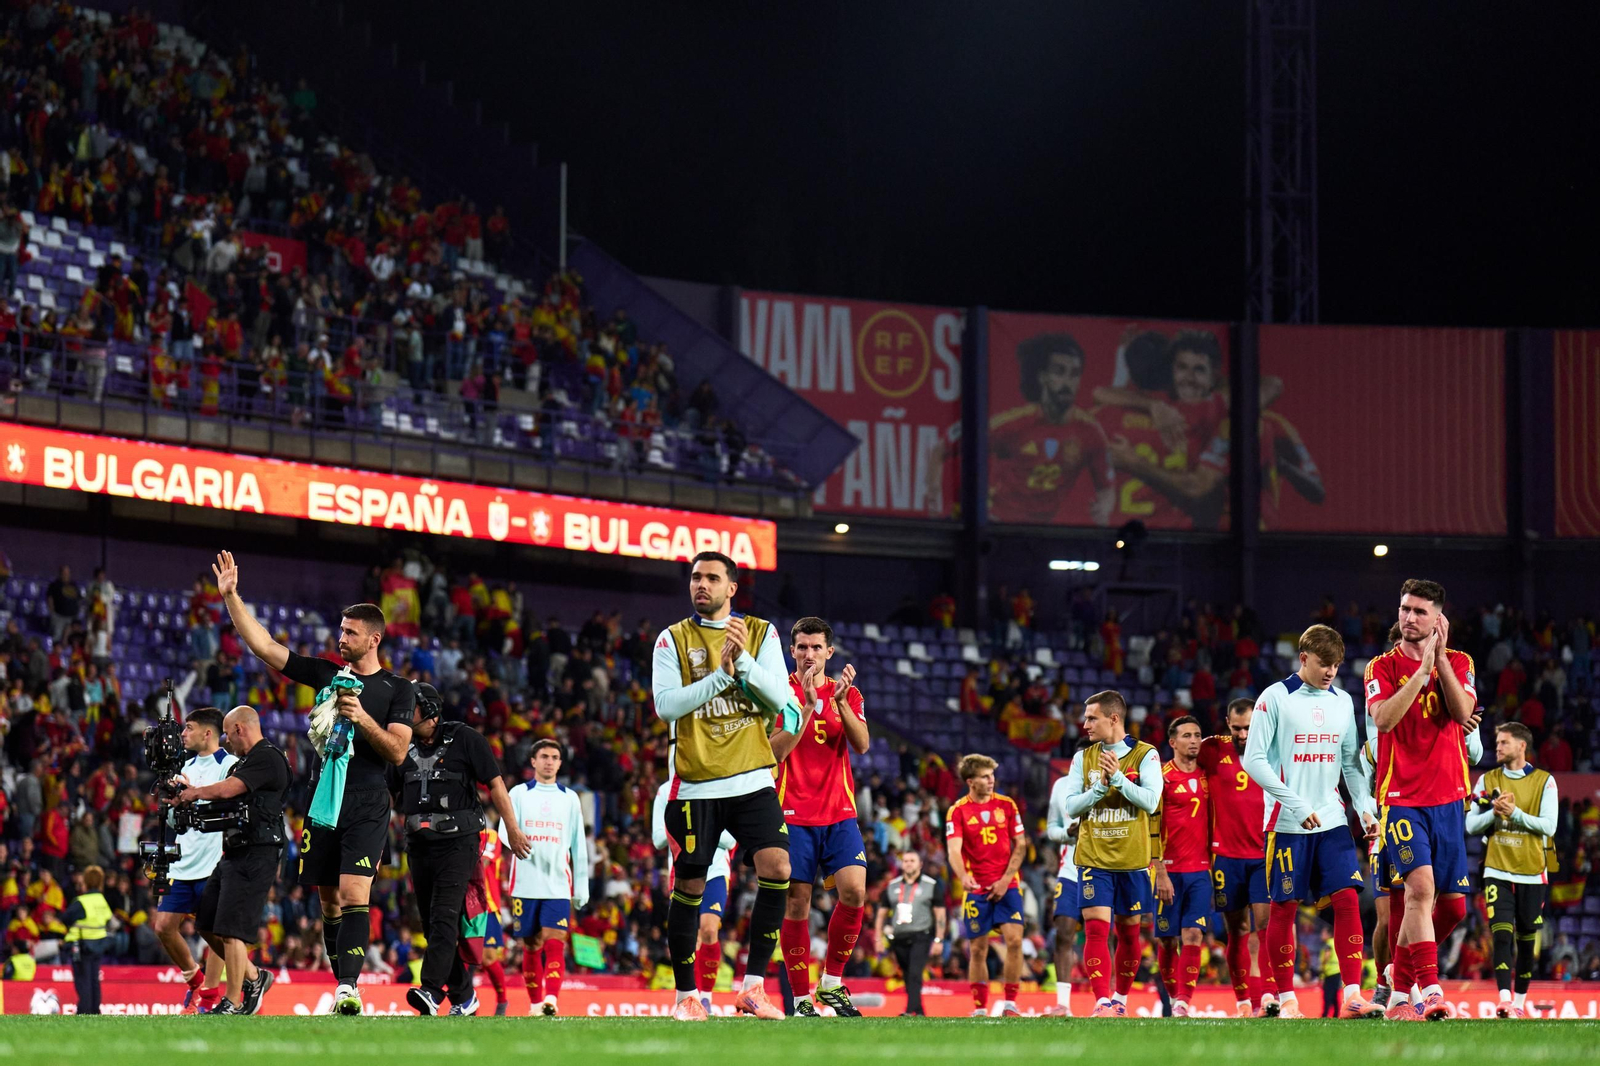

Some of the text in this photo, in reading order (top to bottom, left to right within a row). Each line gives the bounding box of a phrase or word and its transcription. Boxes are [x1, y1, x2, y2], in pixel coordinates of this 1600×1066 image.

[44, 446, 264, 513] BULGARIA
[308, 481, 473, 538] ESPAÑA
[564, 512, 757, 569] BULGARIA
[1418, 691, 1440, 719] 10
[723, 715, 754, 732] RESPECT
[813, 719, 828, 745] 5
[1235, 770, 1248, 792] 9
[681, 801, 692, 830] 1
[1190, 797, 1201, 818] 7
[979, 826, 998, 846] 15
[1101, 828, 1129, 837] RESPECT
[1387, 818, 1414, 846] 10
[1275, 847, 1294, 873] 11
[1214, 869, 1226, 890] 9
